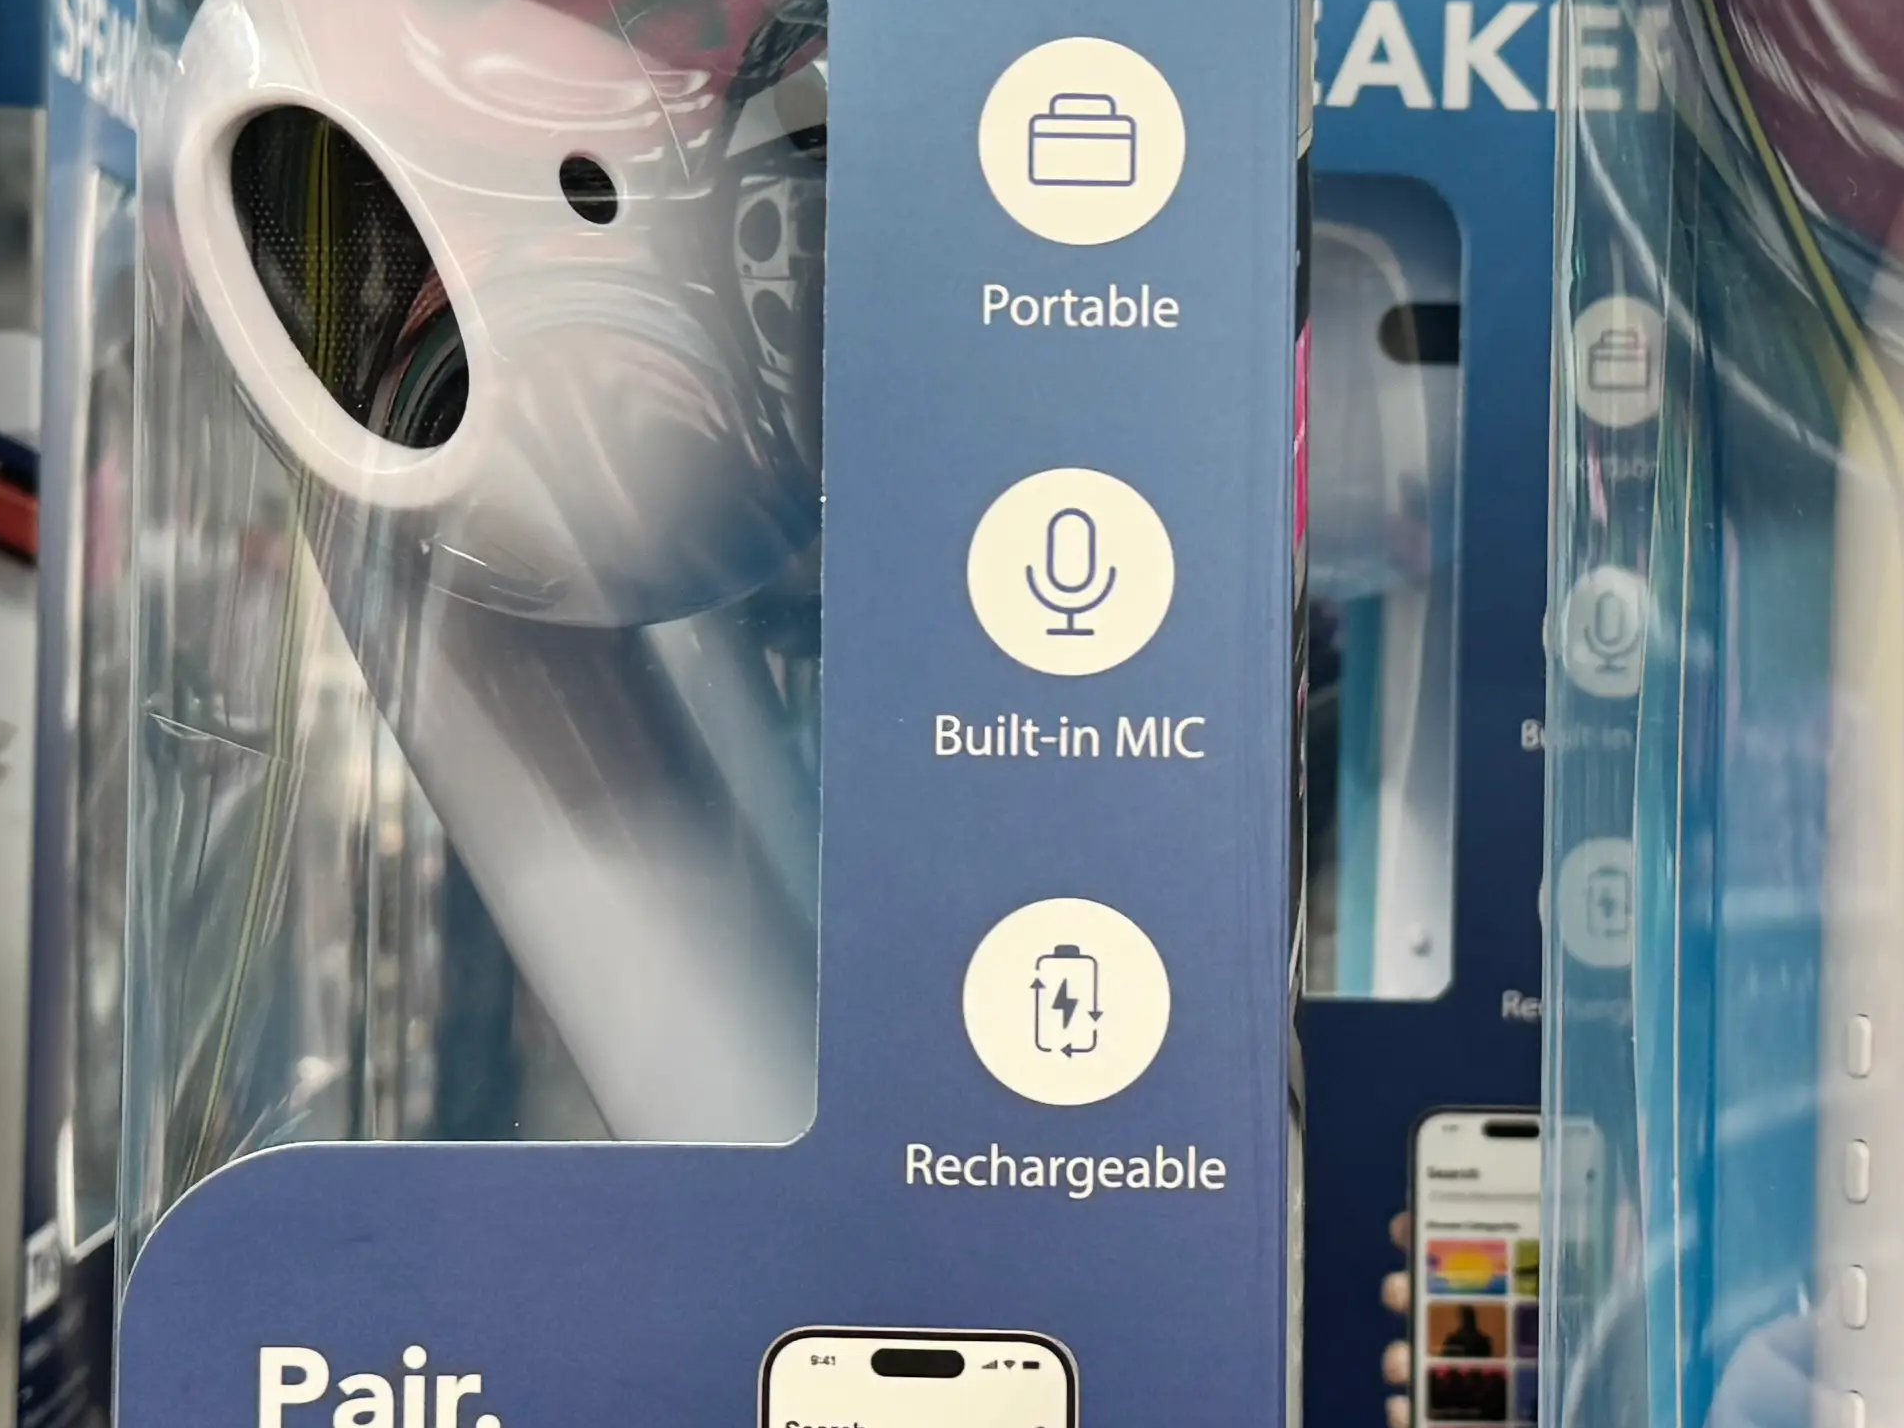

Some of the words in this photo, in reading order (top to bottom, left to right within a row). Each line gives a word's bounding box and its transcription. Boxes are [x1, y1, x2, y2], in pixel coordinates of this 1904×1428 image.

[982, 284, 1179, 329] Portable
[934, 713, 1100, 759] Built-in
[1116, 716, 1205, 760] MIC
[905, 1141, 1226, 1199] Rechargeable
